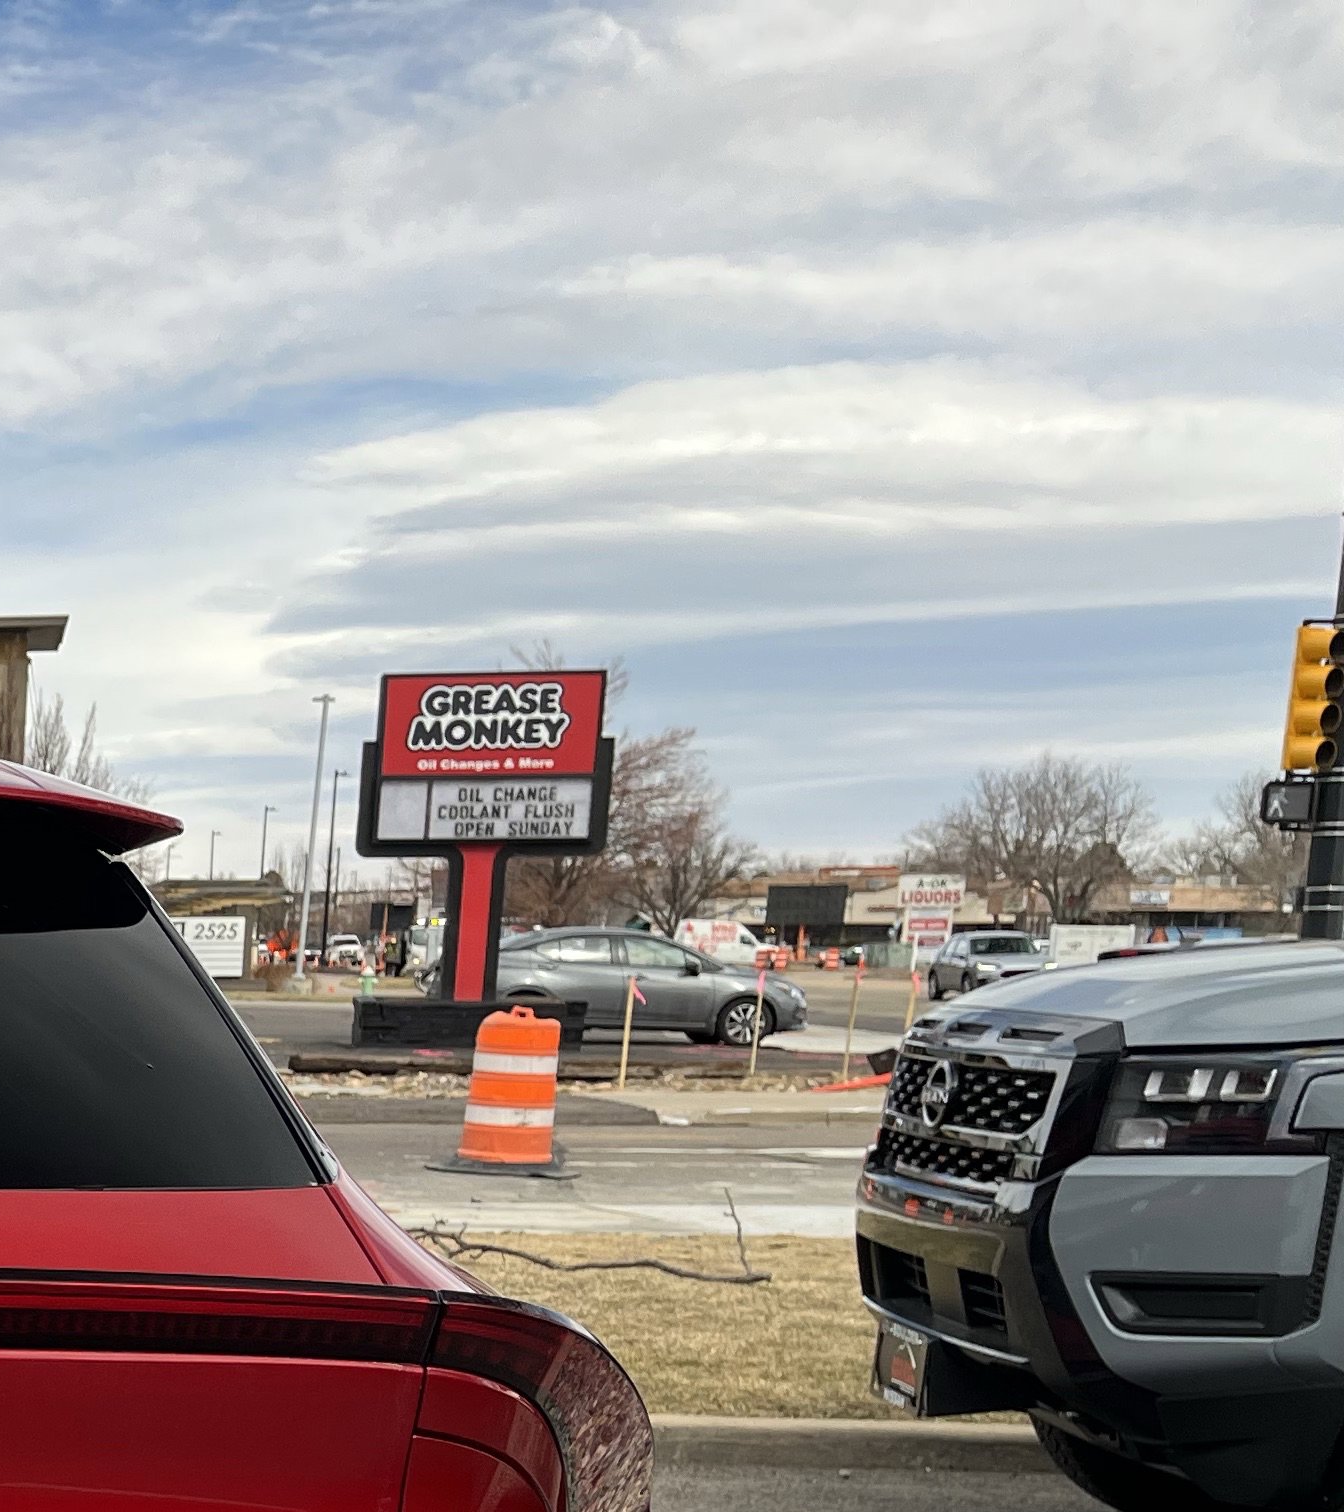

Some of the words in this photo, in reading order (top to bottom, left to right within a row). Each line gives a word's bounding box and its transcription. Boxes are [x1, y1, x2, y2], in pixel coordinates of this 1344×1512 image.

[423, 686, 561, 718] GREASE
[410, 717, 567, 747] MONKEY
[417, 759, 437, 771] Oil
[440, 759, 500, 772] Changes
[503, 757, 515, 770] &
[518, 757, 554, 770] More
[458, 788, 484, 802] OIL
[493, 786, 559, 802] CHANGE
[438, 804, 512, 820] COOLANT
[524, 803, 575, 819] FLUSH
[454, 822, 495, 837] OPEN
[508, 821, 575, 837] SUNDAY
[901, 890, 961, 904] LIQUORS
[193, 922, 238, 940] 2525
